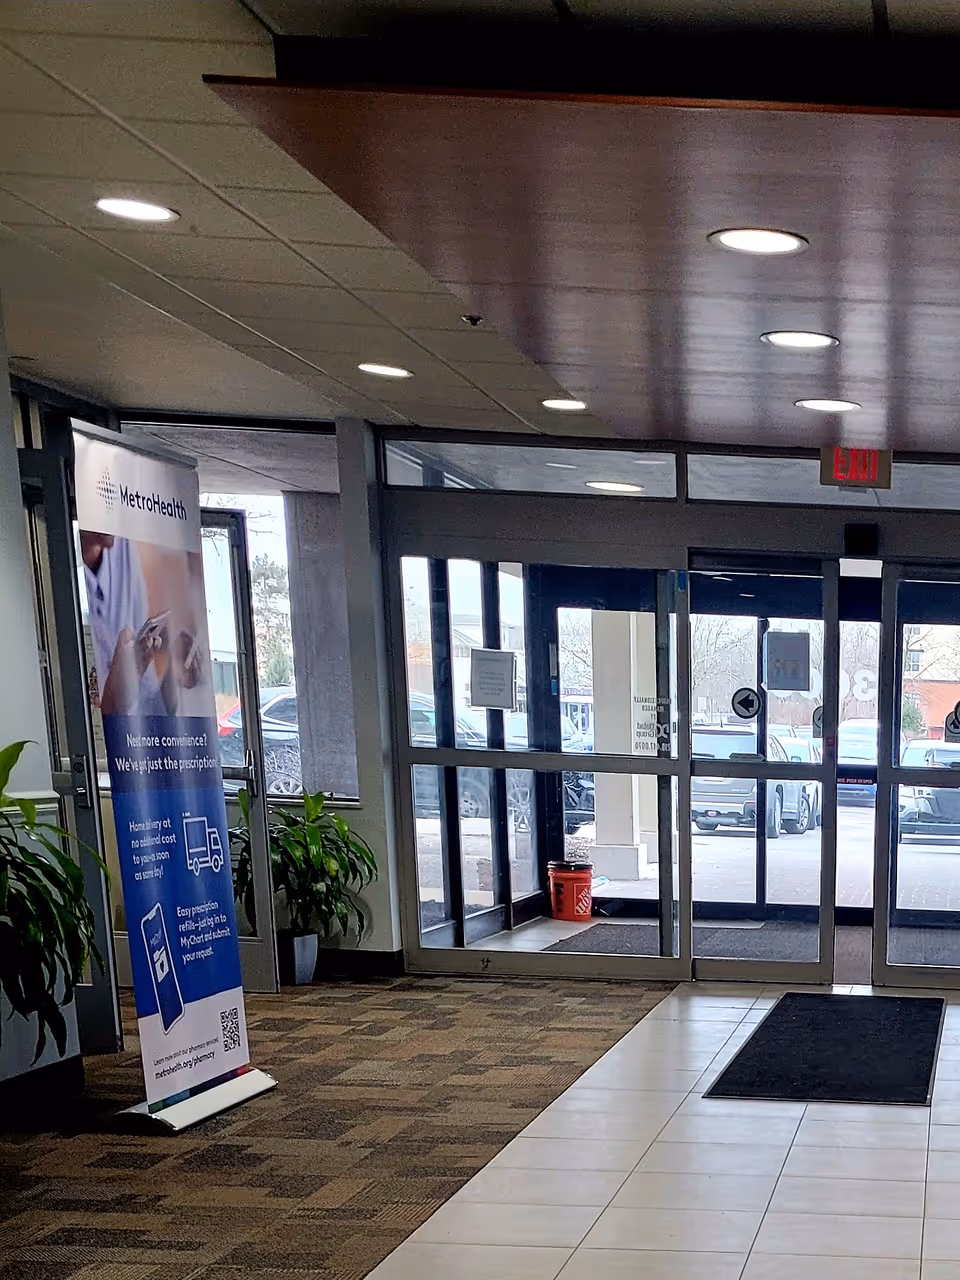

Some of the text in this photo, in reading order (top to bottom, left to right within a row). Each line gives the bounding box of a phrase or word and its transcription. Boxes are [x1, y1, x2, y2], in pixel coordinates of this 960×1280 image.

[833, 447, 879, 481] EXIT
[120, 484, 187, 520] MetroHealth
[141, 737, 160, 747] more
[161, 733, 208, 747] convenience?
[115, 757, 139, 772] We've
[147, 757, 162, 774] just
[164, 756, 179, 770] the
[162, 818, 172, 828] at
[131, 839, 140, 848] no
[161, 833, 177, 844] cost
[132, 854, 140, 865] to
[134, 872, 143, 881] as
[176, 906, 191, 918] Easy
[220, 913, 227, 922] to
[180, 935, 204, 948] MyChart
[212, 926, 231, 939] submit
[182, 951, 196, 965] your
